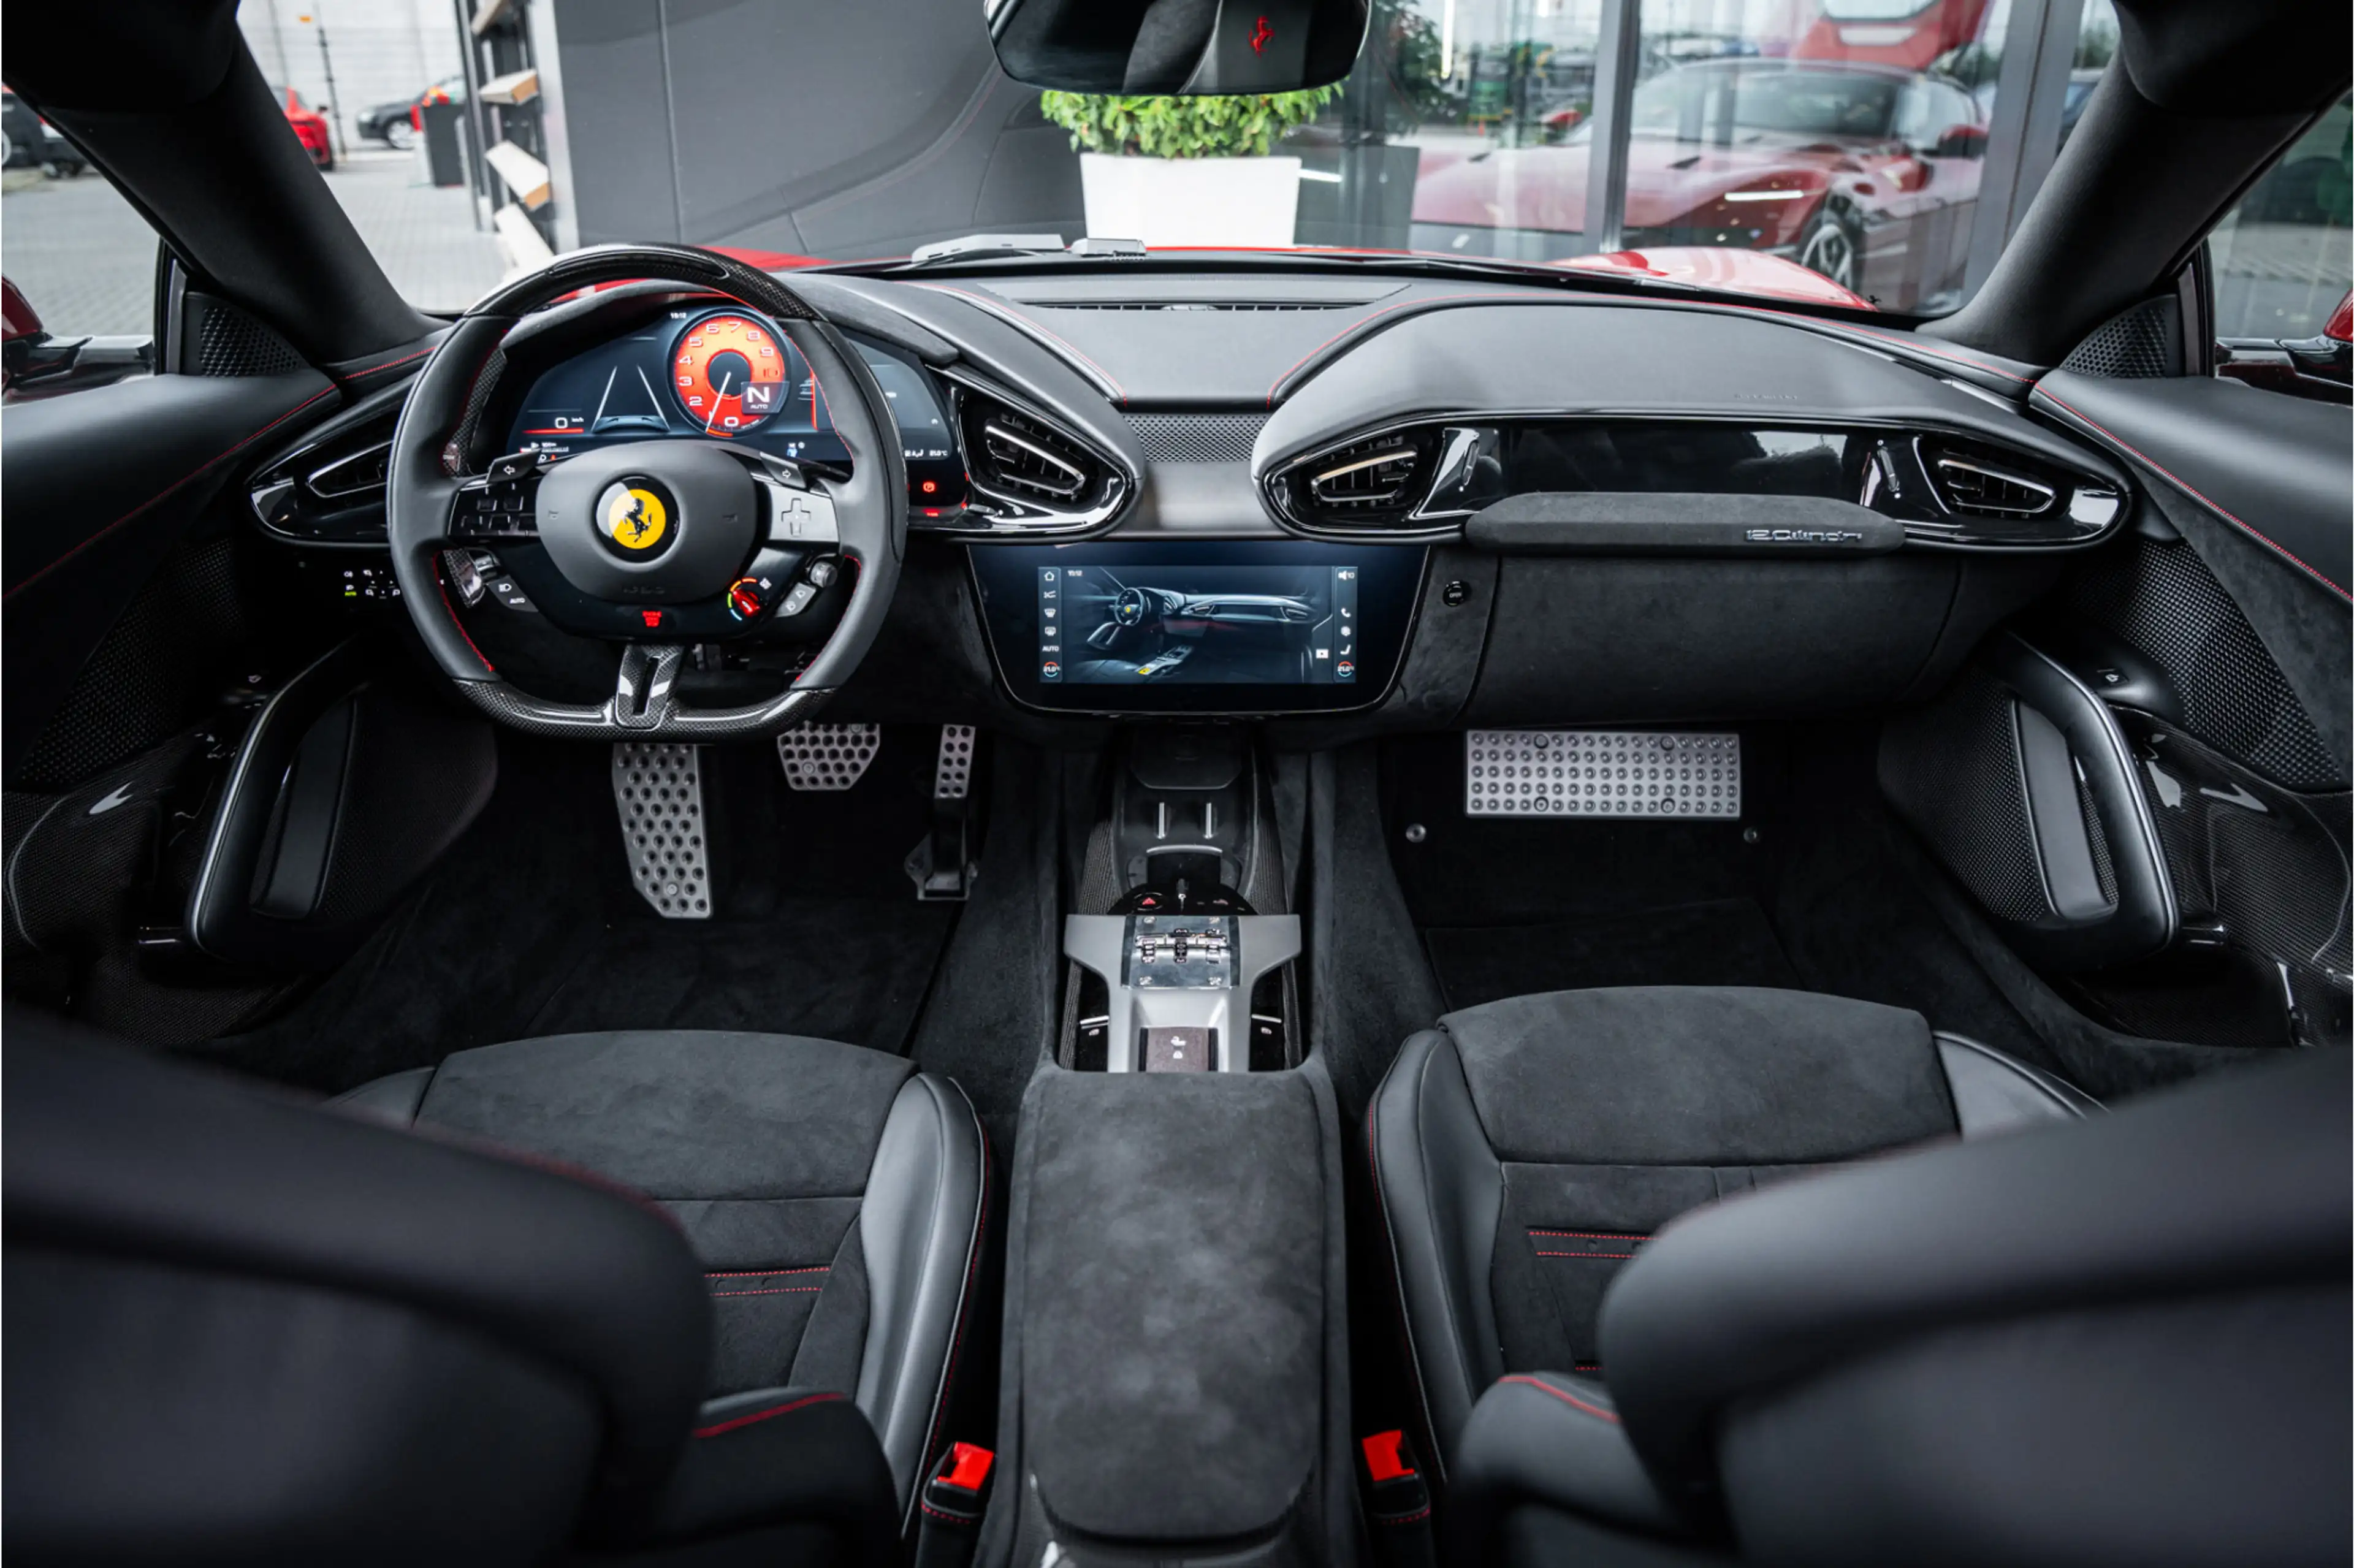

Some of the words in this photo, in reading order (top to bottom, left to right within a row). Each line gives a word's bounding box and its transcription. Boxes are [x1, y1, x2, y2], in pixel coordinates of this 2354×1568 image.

[706, 323, 720, 333] 6
[728, 321, 741, 332] 7
[747, 331, 760, 340] 8
[689, 337, 703, 346] 5
[761, 347, 774, 356] 9
[679, 356, 692, 365] 4
[679, 376, 692, 386] 3
[747, 387, 769, 403] N
[689, 396, 703, 406] 2
[555, 417, 568, 429] 0
[724, 417, 738, 427] 0
